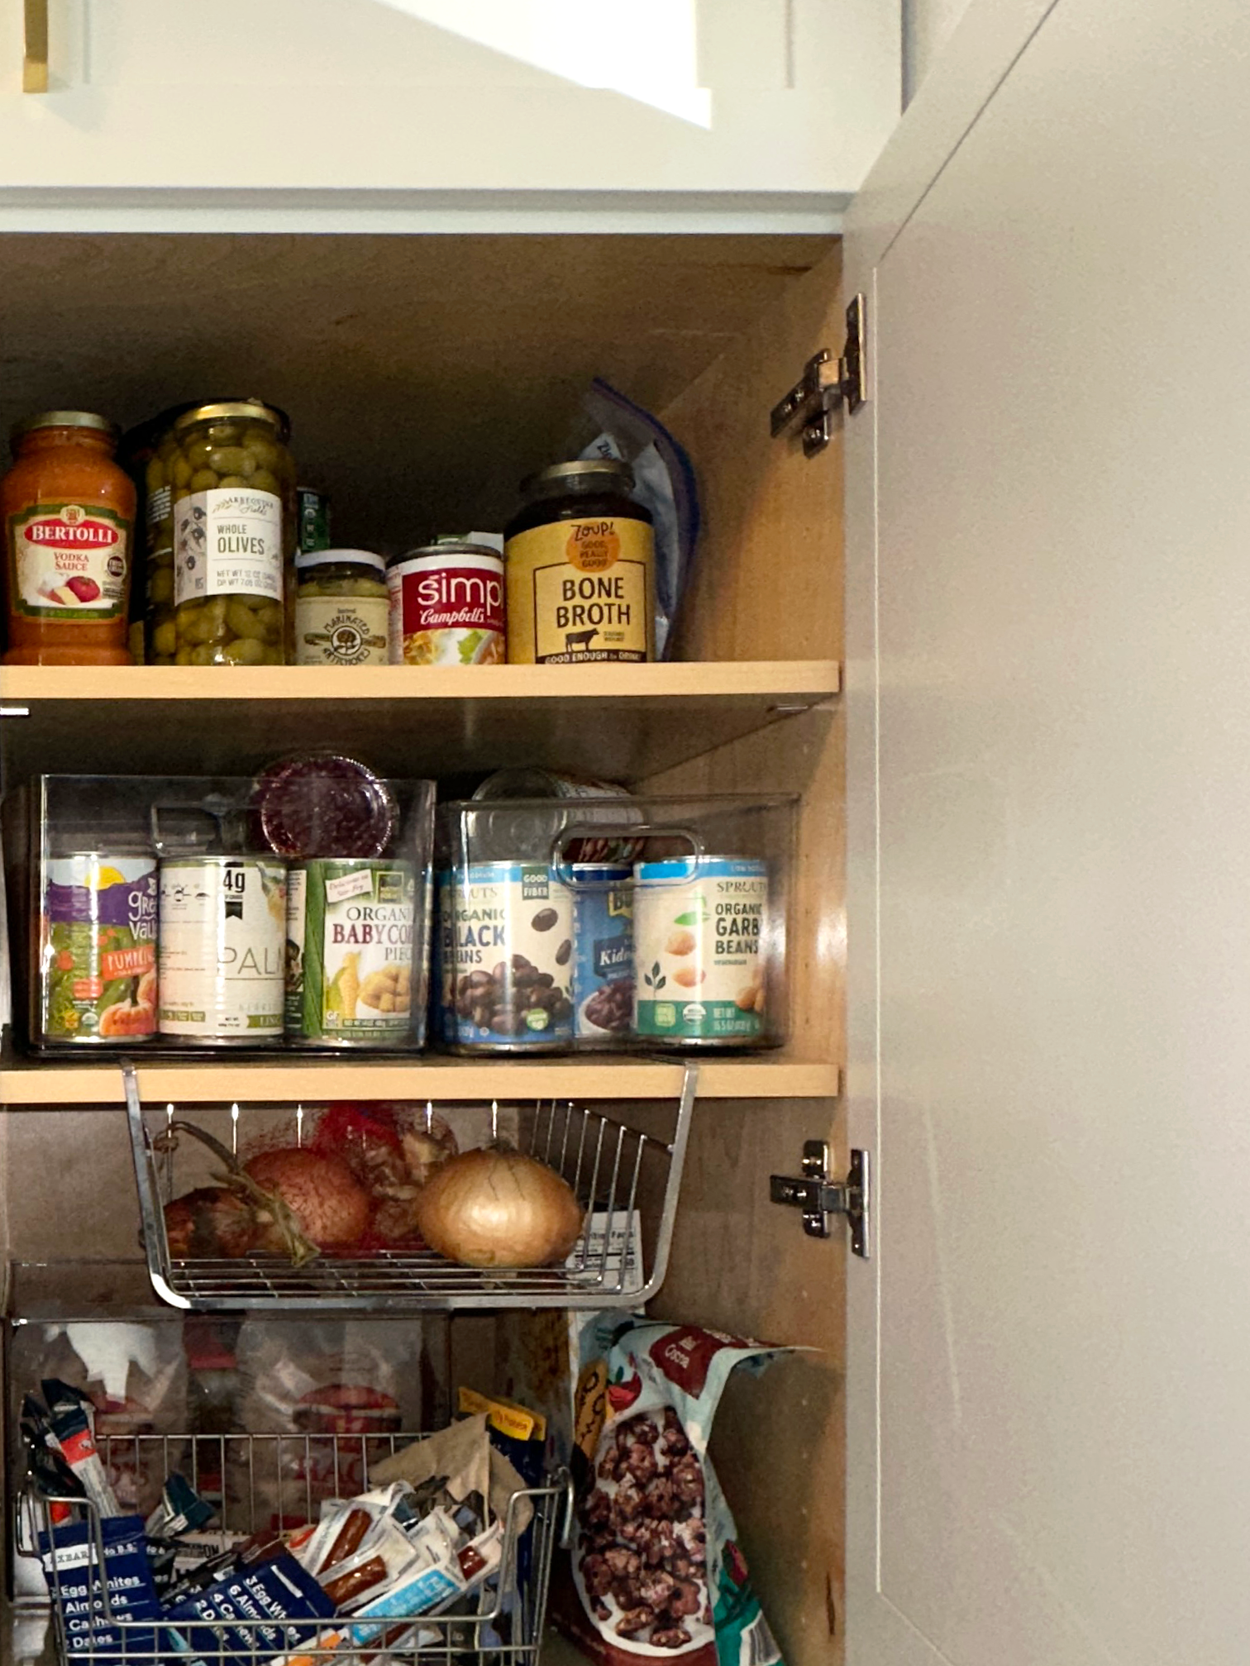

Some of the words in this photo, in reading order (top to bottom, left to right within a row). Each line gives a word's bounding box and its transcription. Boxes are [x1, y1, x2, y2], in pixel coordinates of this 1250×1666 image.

[31, 525, 113, 544] BERTOLLI
[217, 524, 247, 535] WHOLE
[217, 537, 265, 556] OLIVES
[54, 552, 90, 563] VODKA
[55, 561, 88, 572] SAUCE
[562, 576, 625, 601] BONE
[420, 607, 485, 627] Campbell's
[556, 602, 631, 628] BROTH
[323, 614, 370, 636] MARINATED
[545, 654, 570, 665] GOOD
[572, 651, 608, 662] ENOUGH
[223, 869, 246, 893] 4g
[523, 874, 547, 882] GOOD
[523, 887, 548, 897] FIBER
[332, 923, 386, 945] BABY
[716, 917, 760, 937] GARB
[715, 940, 759, 955] BEANS
[60, 1585, 87, 1598] Egg
[213, 1592, 224, 1603] 4
[229, 1584, 241, 1595] 6
[246, 1575, 257, 1586] 3
[252, 1583, 272, 1606] Egg
[65, 1593, 128, 1614] Almods
